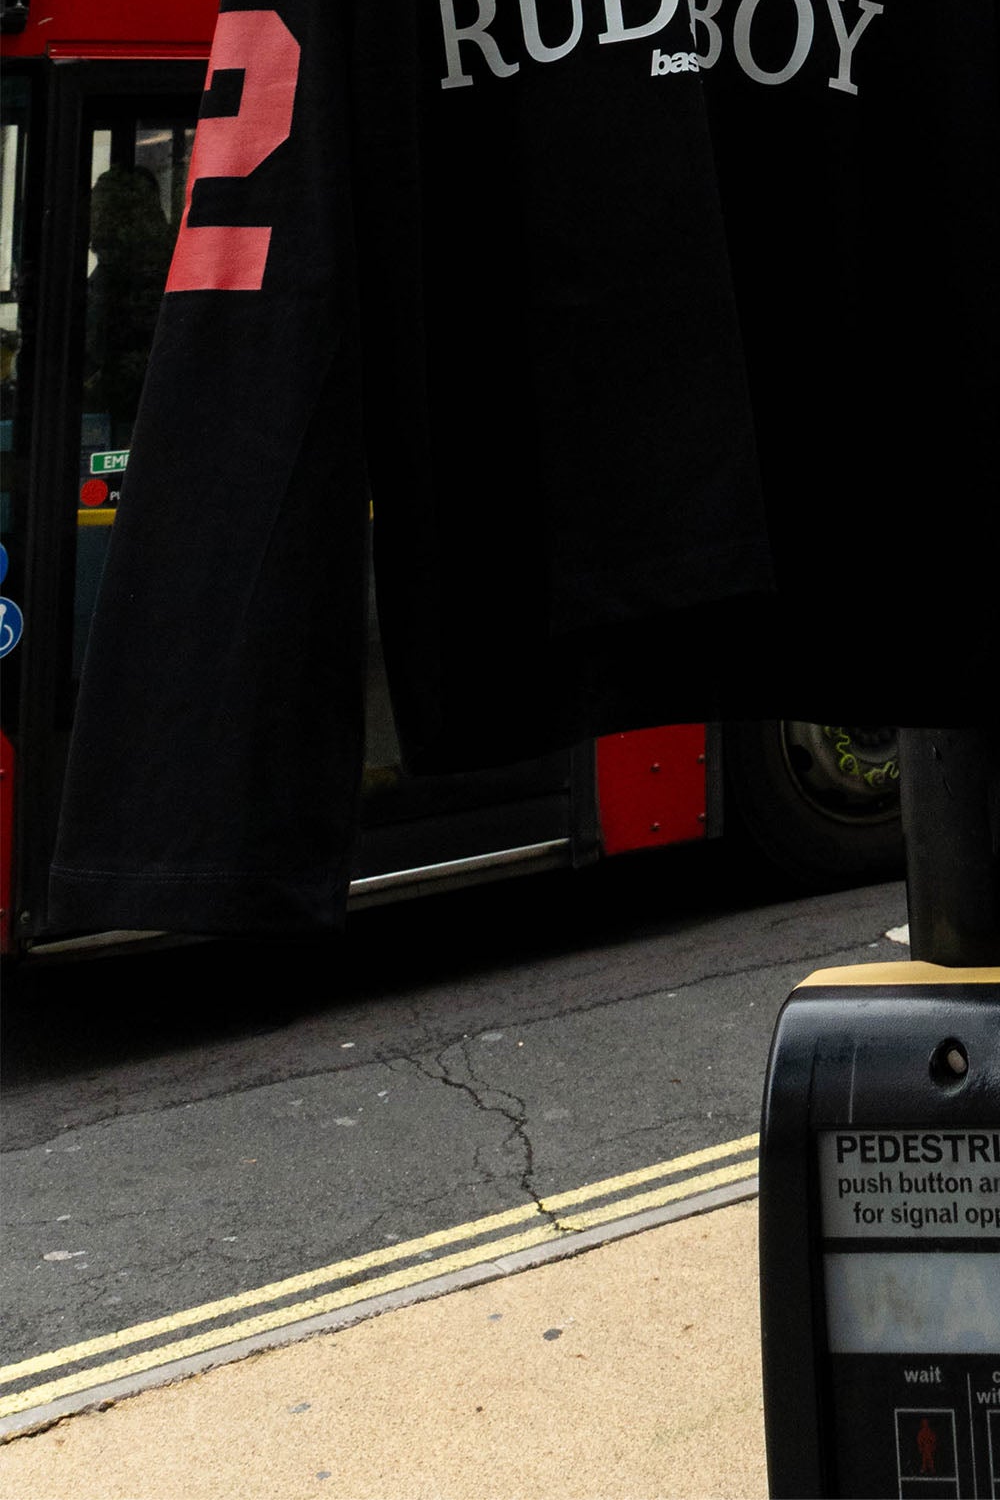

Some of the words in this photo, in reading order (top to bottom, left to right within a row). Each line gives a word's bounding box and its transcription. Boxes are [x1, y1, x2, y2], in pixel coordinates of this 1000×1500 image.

[164, 10, 301, 293] 2
[838, 1171, 892, 1199] push
[899, 1172, 972, 1193] button
[854, 1203, 884, 1223] for
[891, 1202, 959, 1228] signal
[904, 1366, 942, 1384] wait
